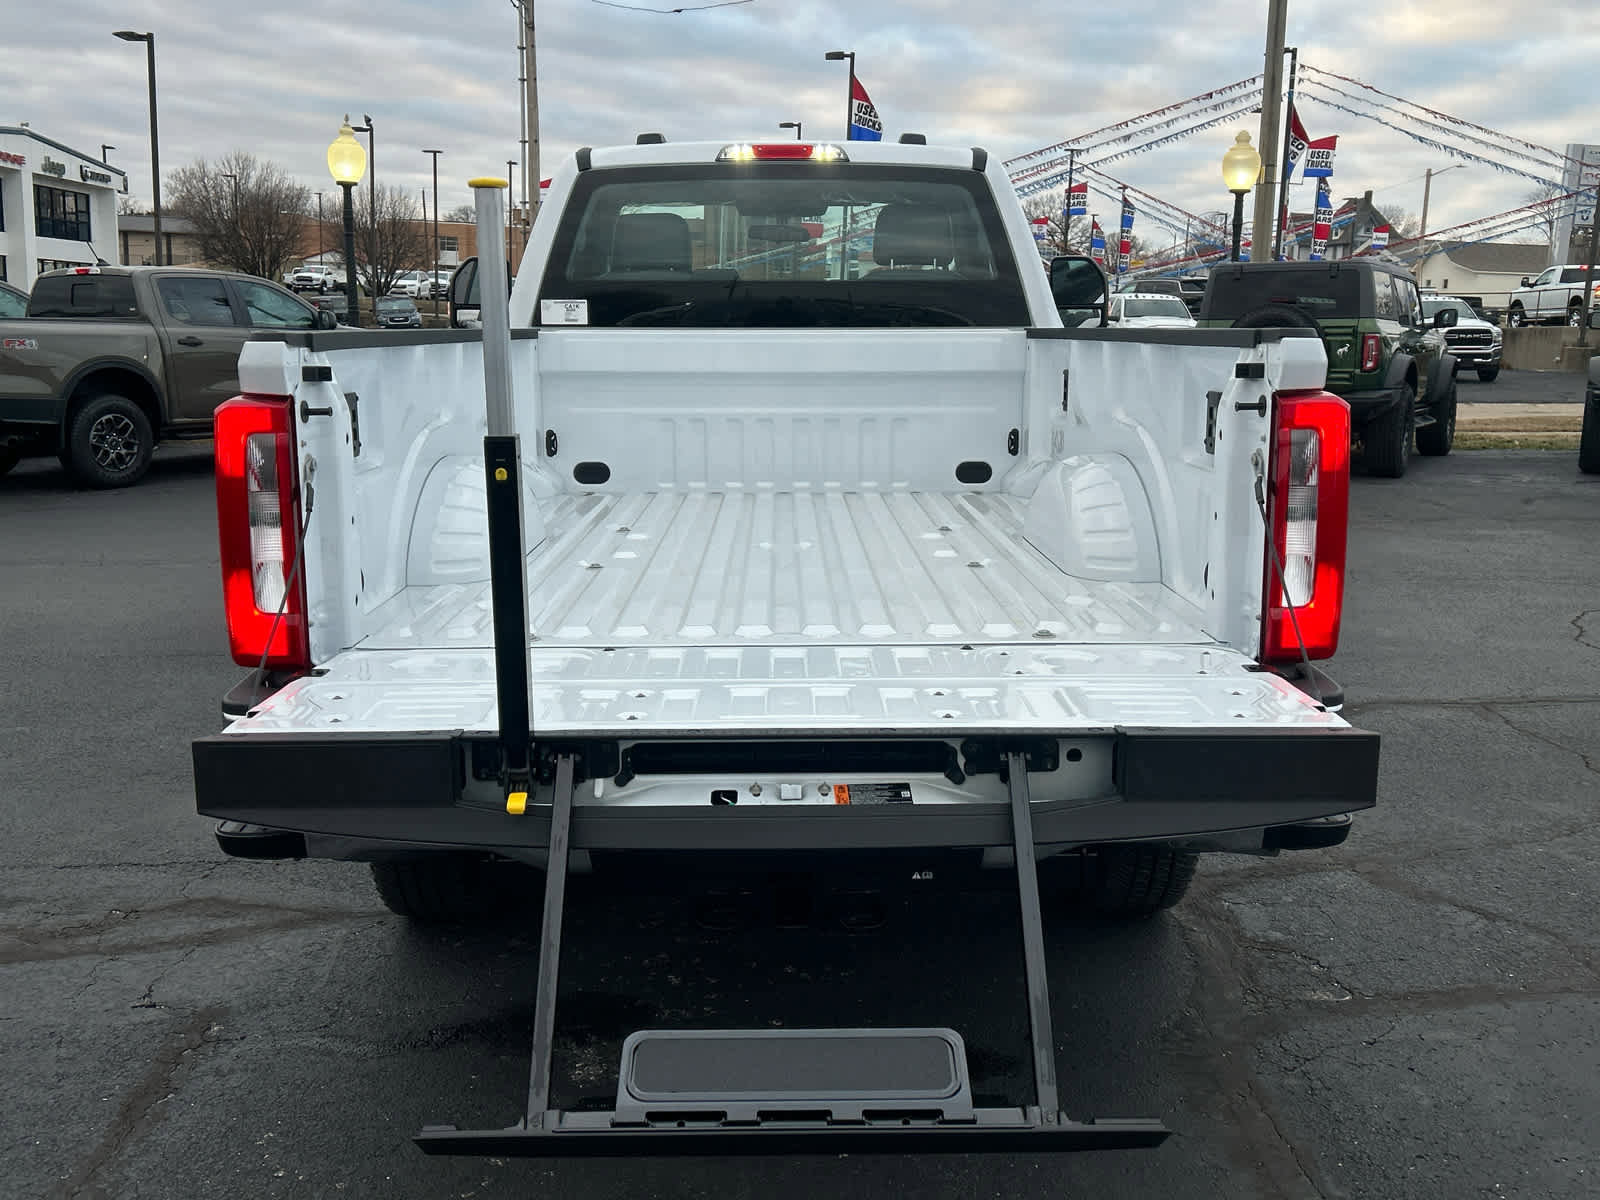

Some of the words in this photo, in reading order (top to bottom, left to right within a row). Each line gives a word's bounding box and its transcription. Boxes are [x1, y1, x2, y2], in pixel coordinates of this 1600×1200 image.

[857, 102, 879, 119] USED
[854, 113, 882, 131] TRUCKS
[1310, 150, 1331, 160] USED
